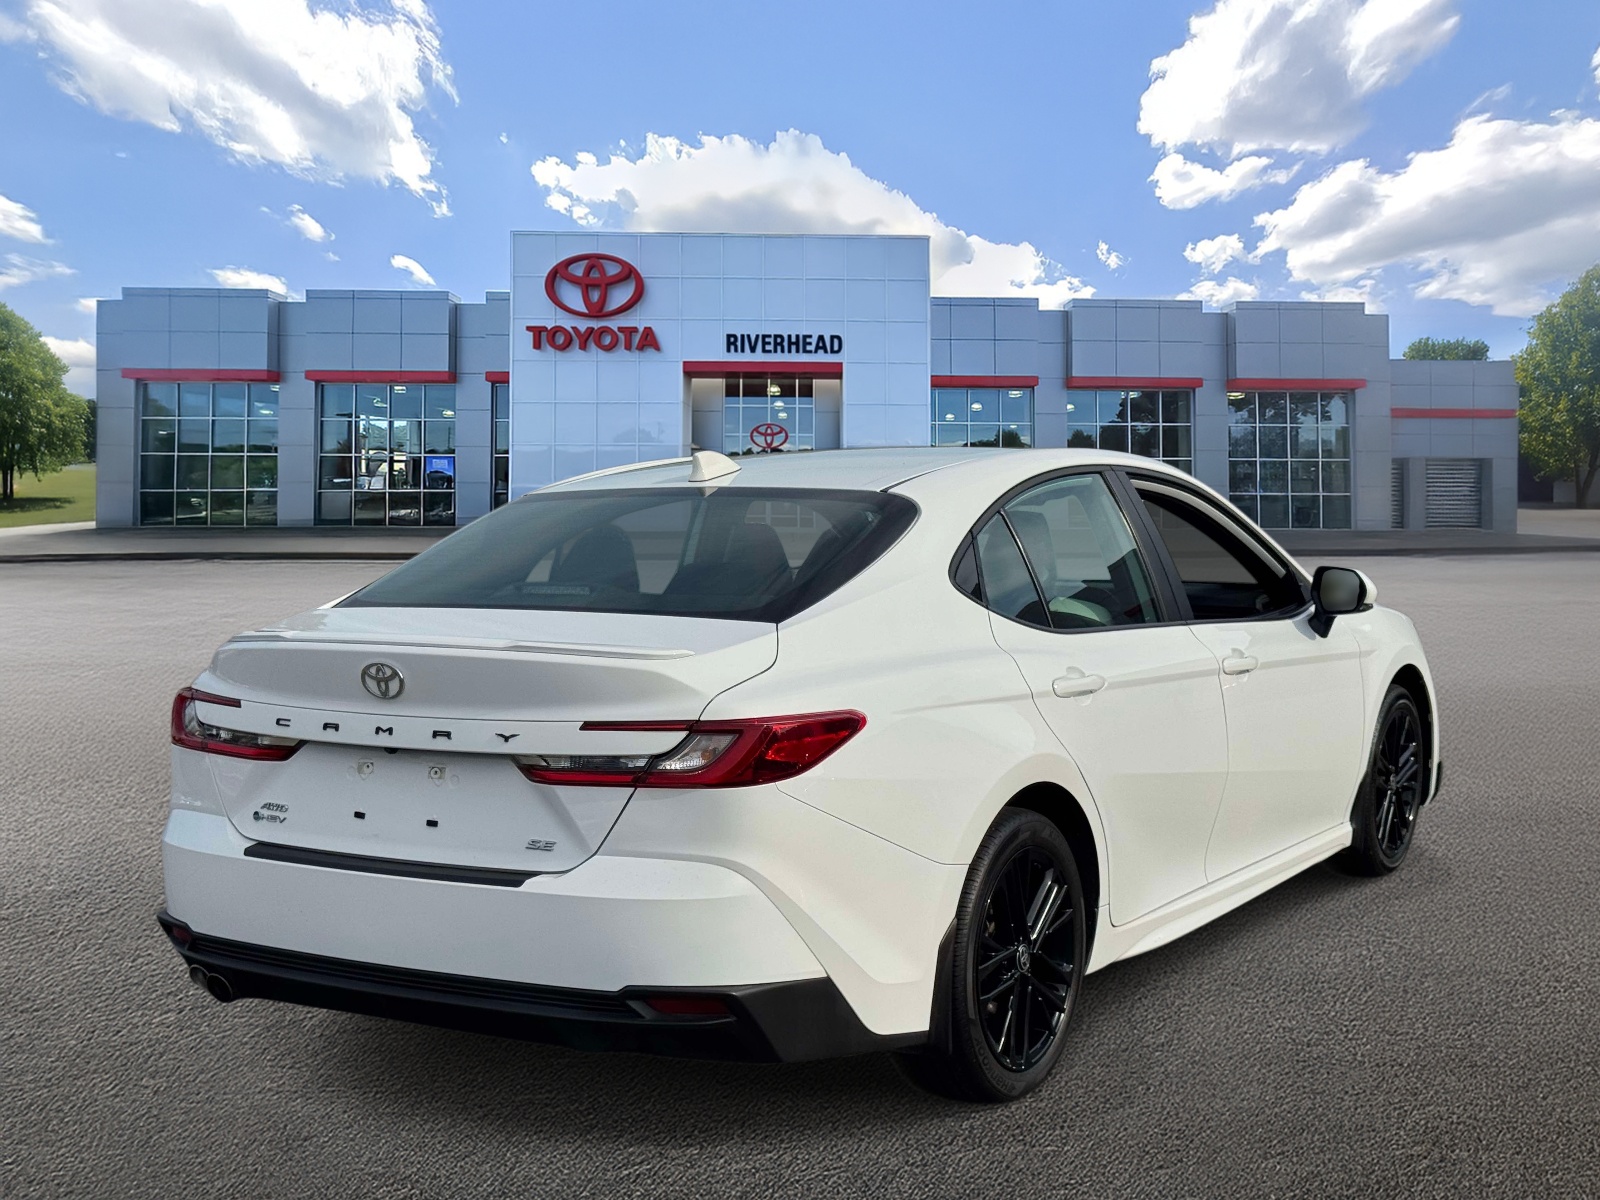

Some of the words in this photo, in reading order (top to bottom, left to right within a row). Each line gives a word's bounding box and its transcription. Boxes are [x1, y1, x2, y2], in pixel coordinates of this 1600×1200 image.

[525, 325, 661, 352] TOYOTA
[725, 333, 843, 354] RIVERHEAD
[275, 717, 520, 743] CAMRY
[525, 838, 557, 852] SE
